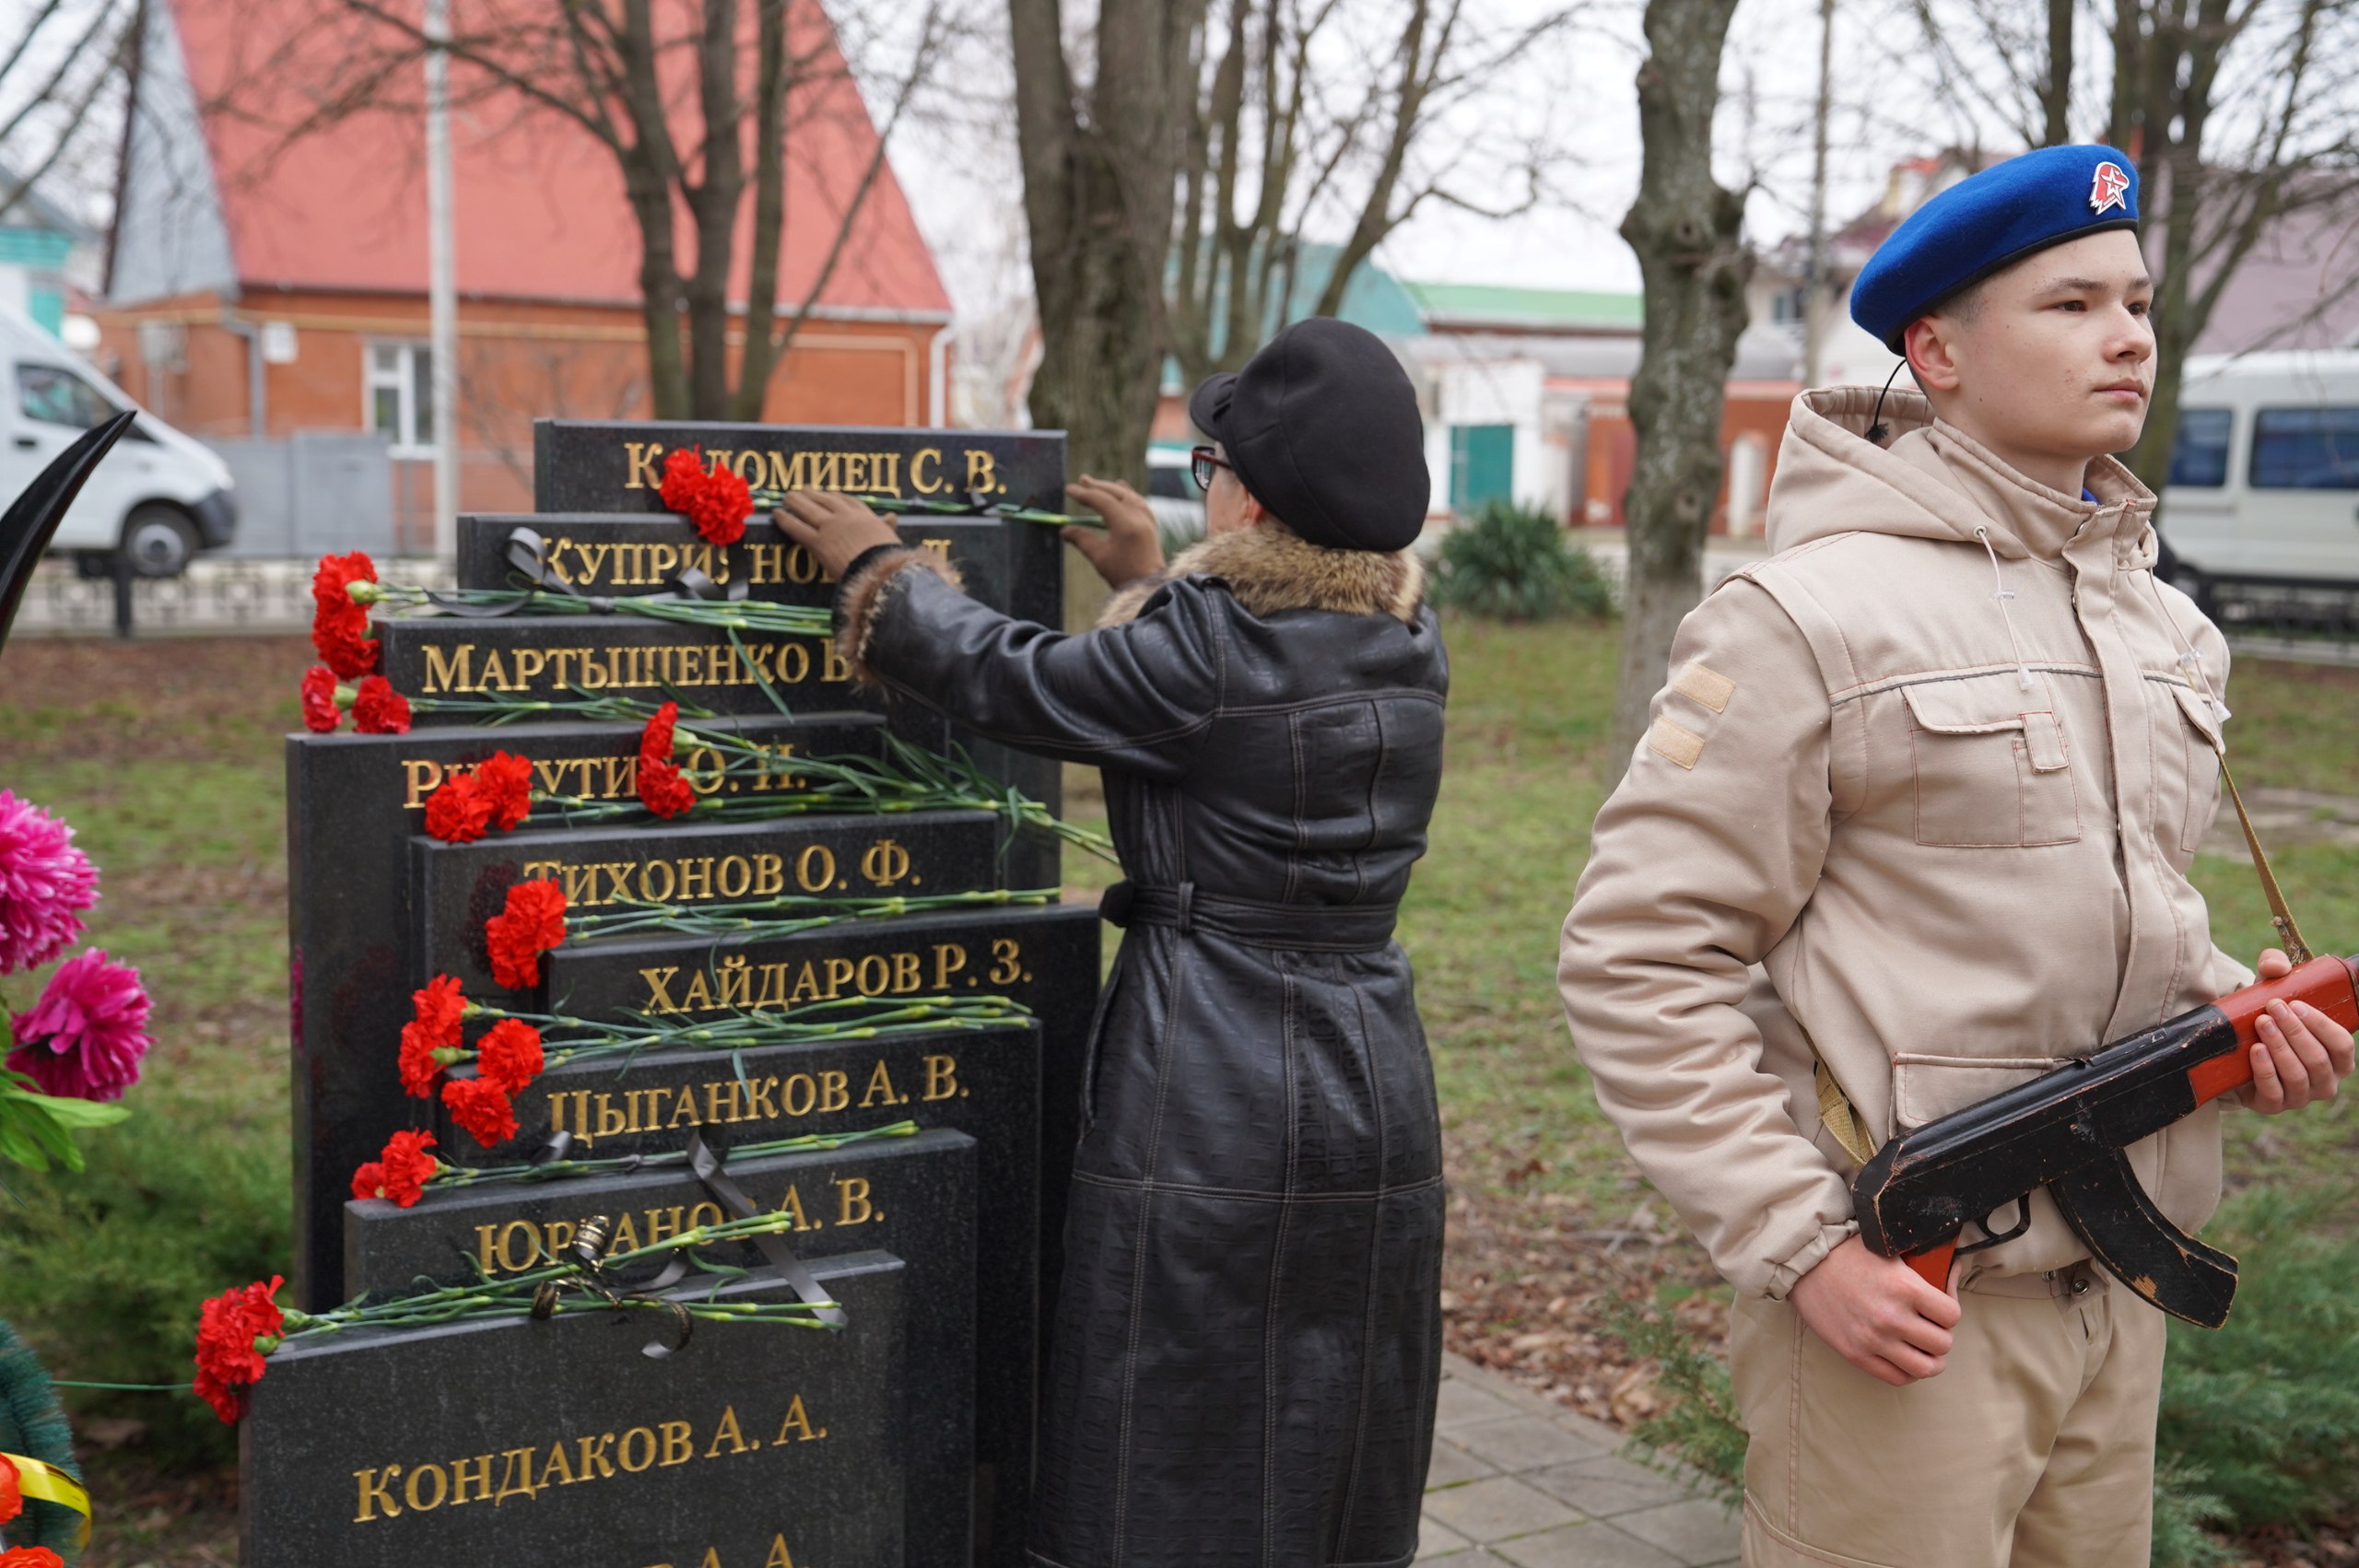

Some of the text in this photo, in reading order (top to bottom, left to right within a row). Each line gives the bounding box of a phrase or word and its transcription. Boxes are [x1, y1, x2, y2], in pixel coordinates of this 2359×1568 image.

[624, 442, 1007, 500] КЛОМИЕЦ С. В.
[533, 536, 840, 585] КУПРИНО
[421, 642, 810, 693] МАРТЫШЕНКО
[687, 747, 739, 794] О.
[523, 838, 921, 907] ТИХОНОВ О. Ф.
[639, 952, 921, 1015] ХАЙДАРОВ
[932, 942, 979, 989] Р.
[546, 1053, 970, 1150] ЦЫГАНКОВ А. В.
[474, 1176, 885, 1275] ЮРАНО А. В.
[353, 1393, 827, 1524] КОНДАКОВ А. А.
